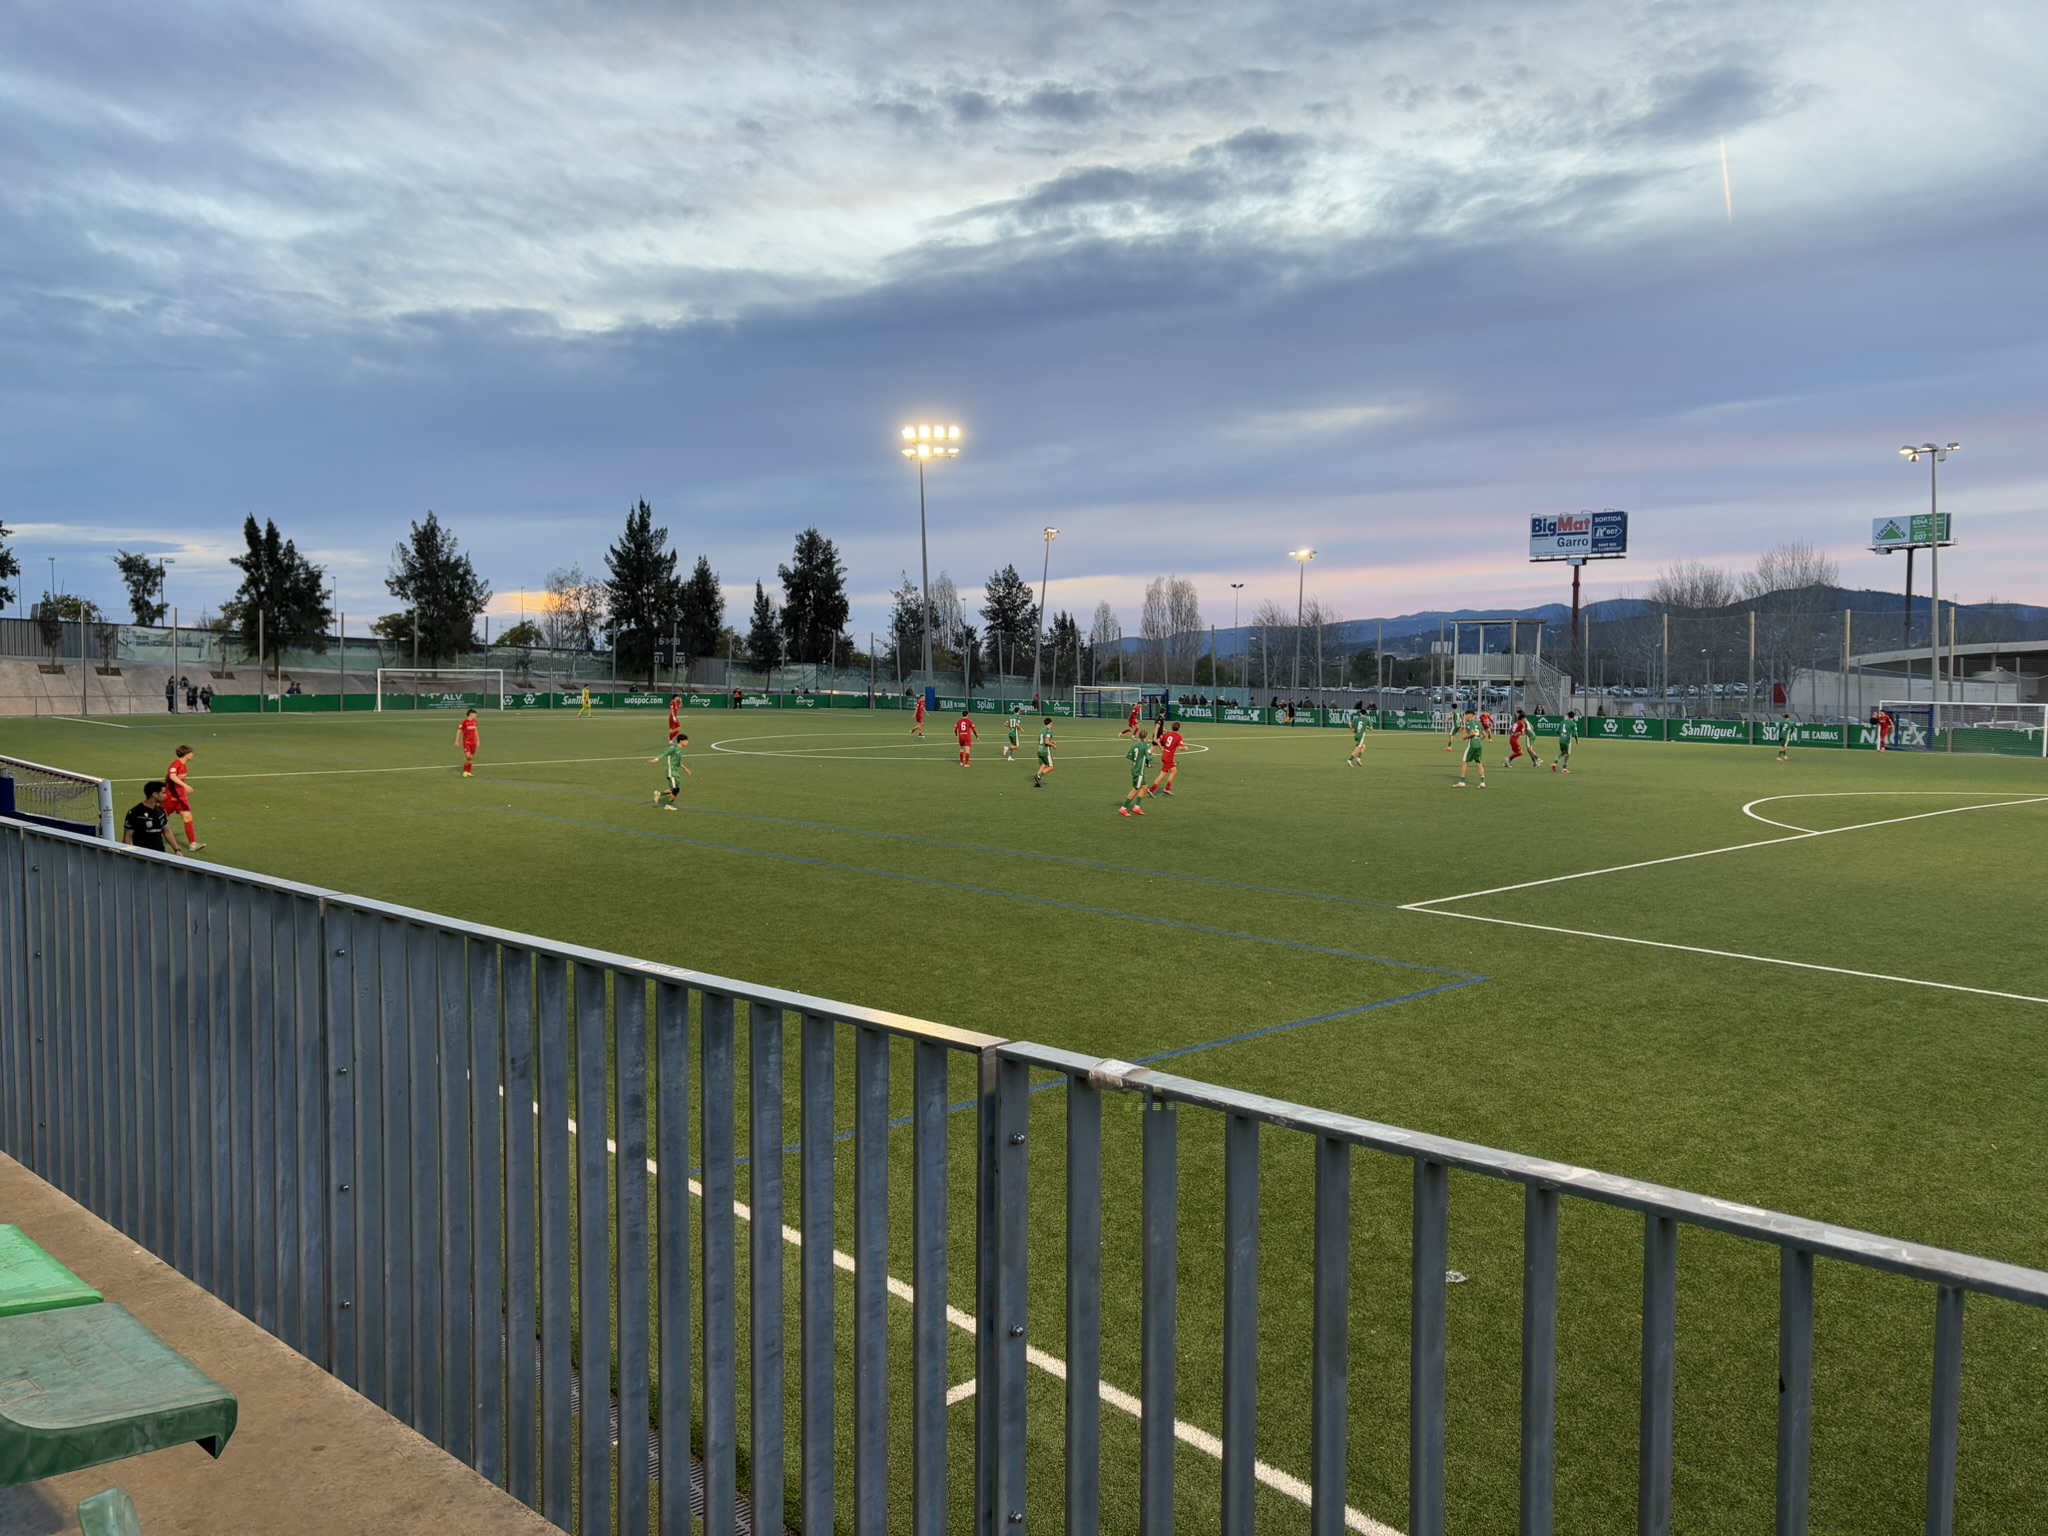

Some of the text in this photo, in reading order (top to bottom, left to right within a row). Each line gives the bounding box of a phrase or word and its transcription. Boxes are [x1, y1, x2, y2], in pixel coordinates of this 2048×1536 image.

[1594, 515, 1622, 523] SORTIDA
[1531, 516, 1591, 537] BigMat
[1606, 527, 1618, 535] 607
[1557, 537, 1589, 548] Garro
[1913, 533, 1927, 541] 607
[442, 693, 463, 701] ALV
[561, 695, 600, 706] SanMuel
[741, 696, 769, 707] anMiguel
[1185, 706, 1212, 718] joma
[961, 721, 967, 731] 6
[1679, 722, 1737, 740] SanMiguel
[1801, 730, 1811, 740] DE
[1812, 730, 1839, 741] CABRAS
[1166, 735, 1174, 748] 9
